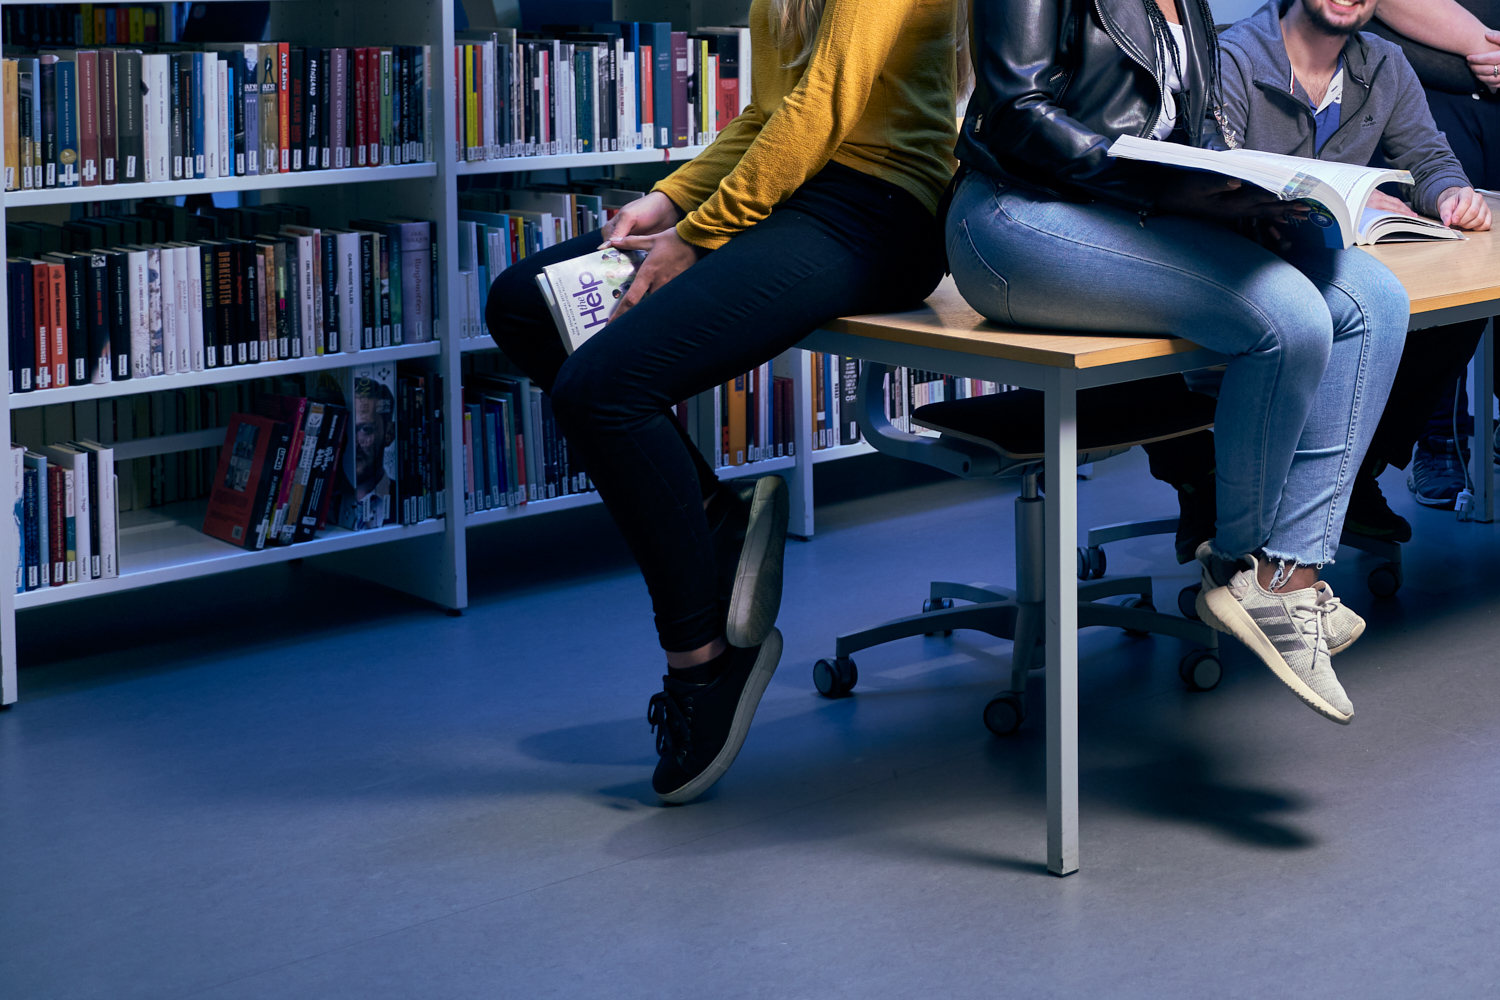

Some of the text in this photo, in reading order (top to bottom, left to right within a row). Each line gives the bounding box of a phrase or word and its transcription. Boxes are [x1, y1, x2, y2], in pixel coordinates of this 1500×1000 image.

[218, 252, 232, 304] DRAKEGUTEN
[573, 271, 609, 329] Help
[577, 296, 588, 311] the
